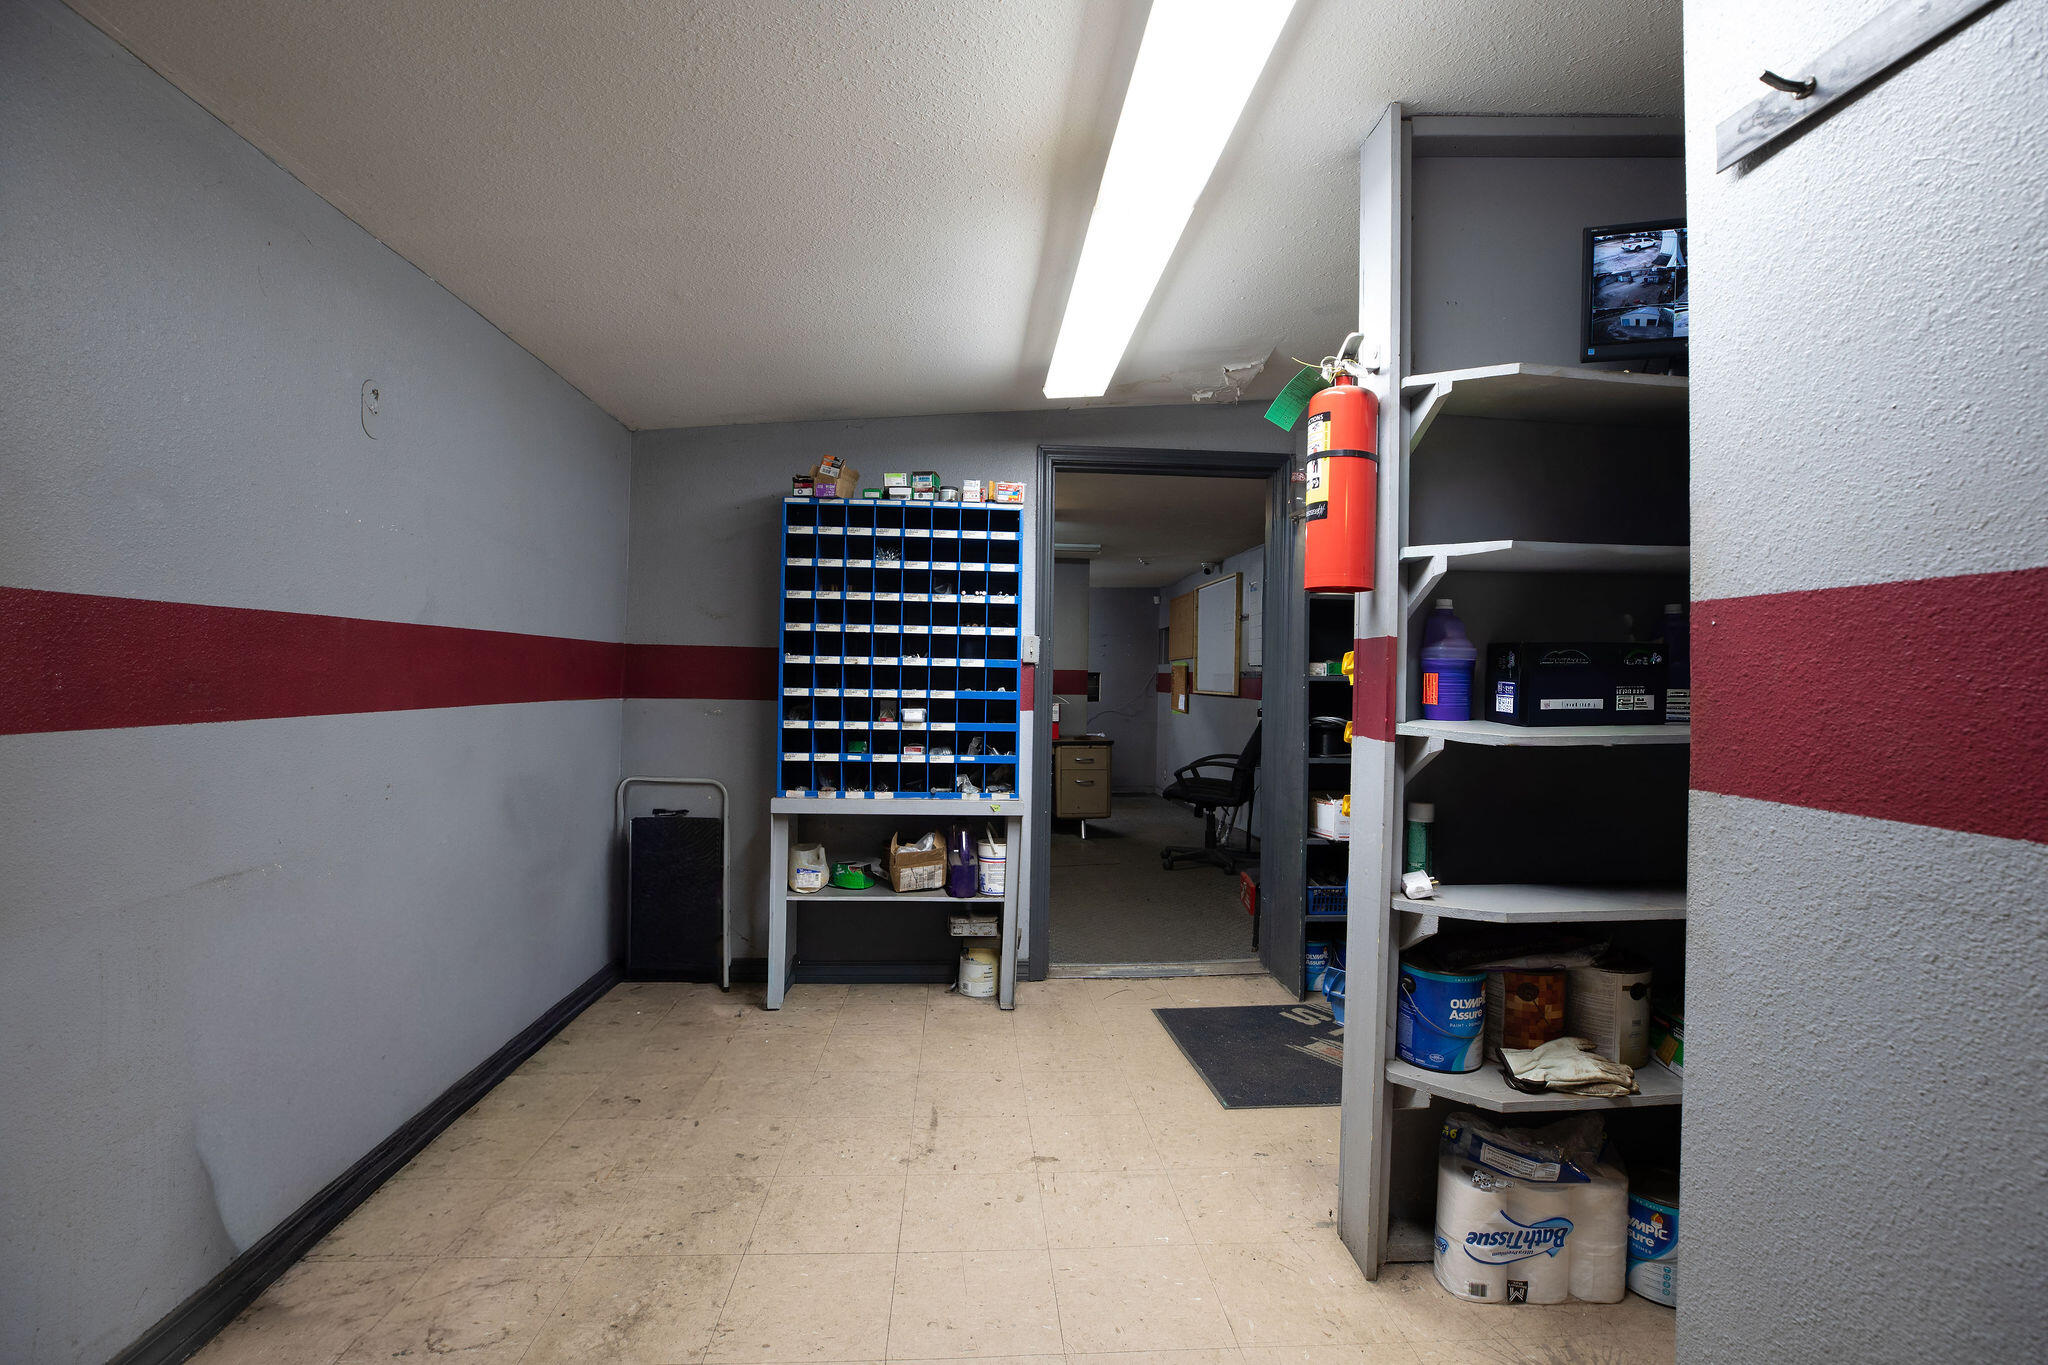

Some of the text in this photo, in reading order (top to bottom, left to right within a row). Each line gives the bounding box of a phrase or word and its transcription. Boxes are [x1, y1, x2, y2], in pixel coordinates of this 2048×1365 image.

[1450, 996, 1486, 1009] OLYMPI
[1449, 1009, 1483, 1020] Assure
[1491, 1249, 1518, 1257] Premium
